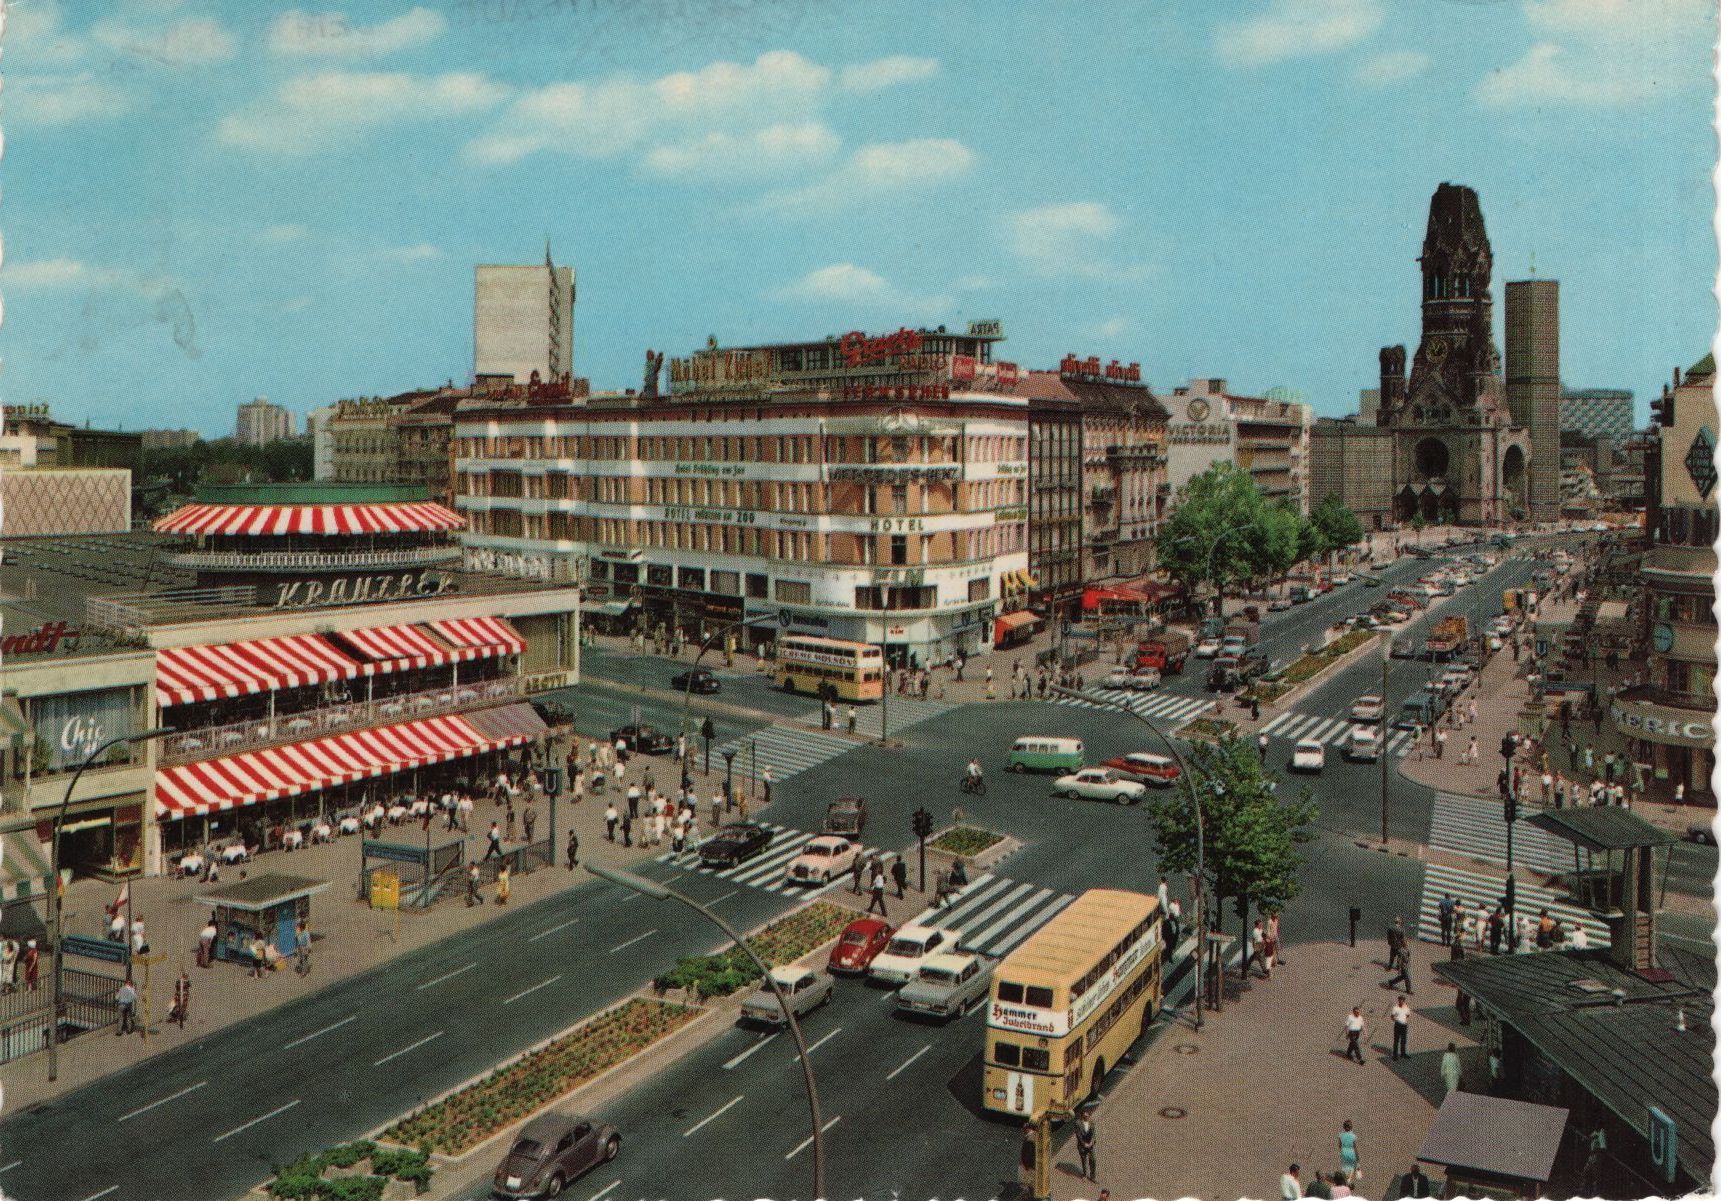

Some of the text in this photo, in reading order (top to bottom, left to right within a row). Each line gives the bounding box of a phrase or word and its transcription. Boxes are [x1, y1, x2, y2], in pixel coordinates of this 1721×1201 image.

[1168, 424, 1230, 436] VICTORIA
[871, 518, 925, 532] HOTEL
[275, 573, 456, 609] KRANZLER
